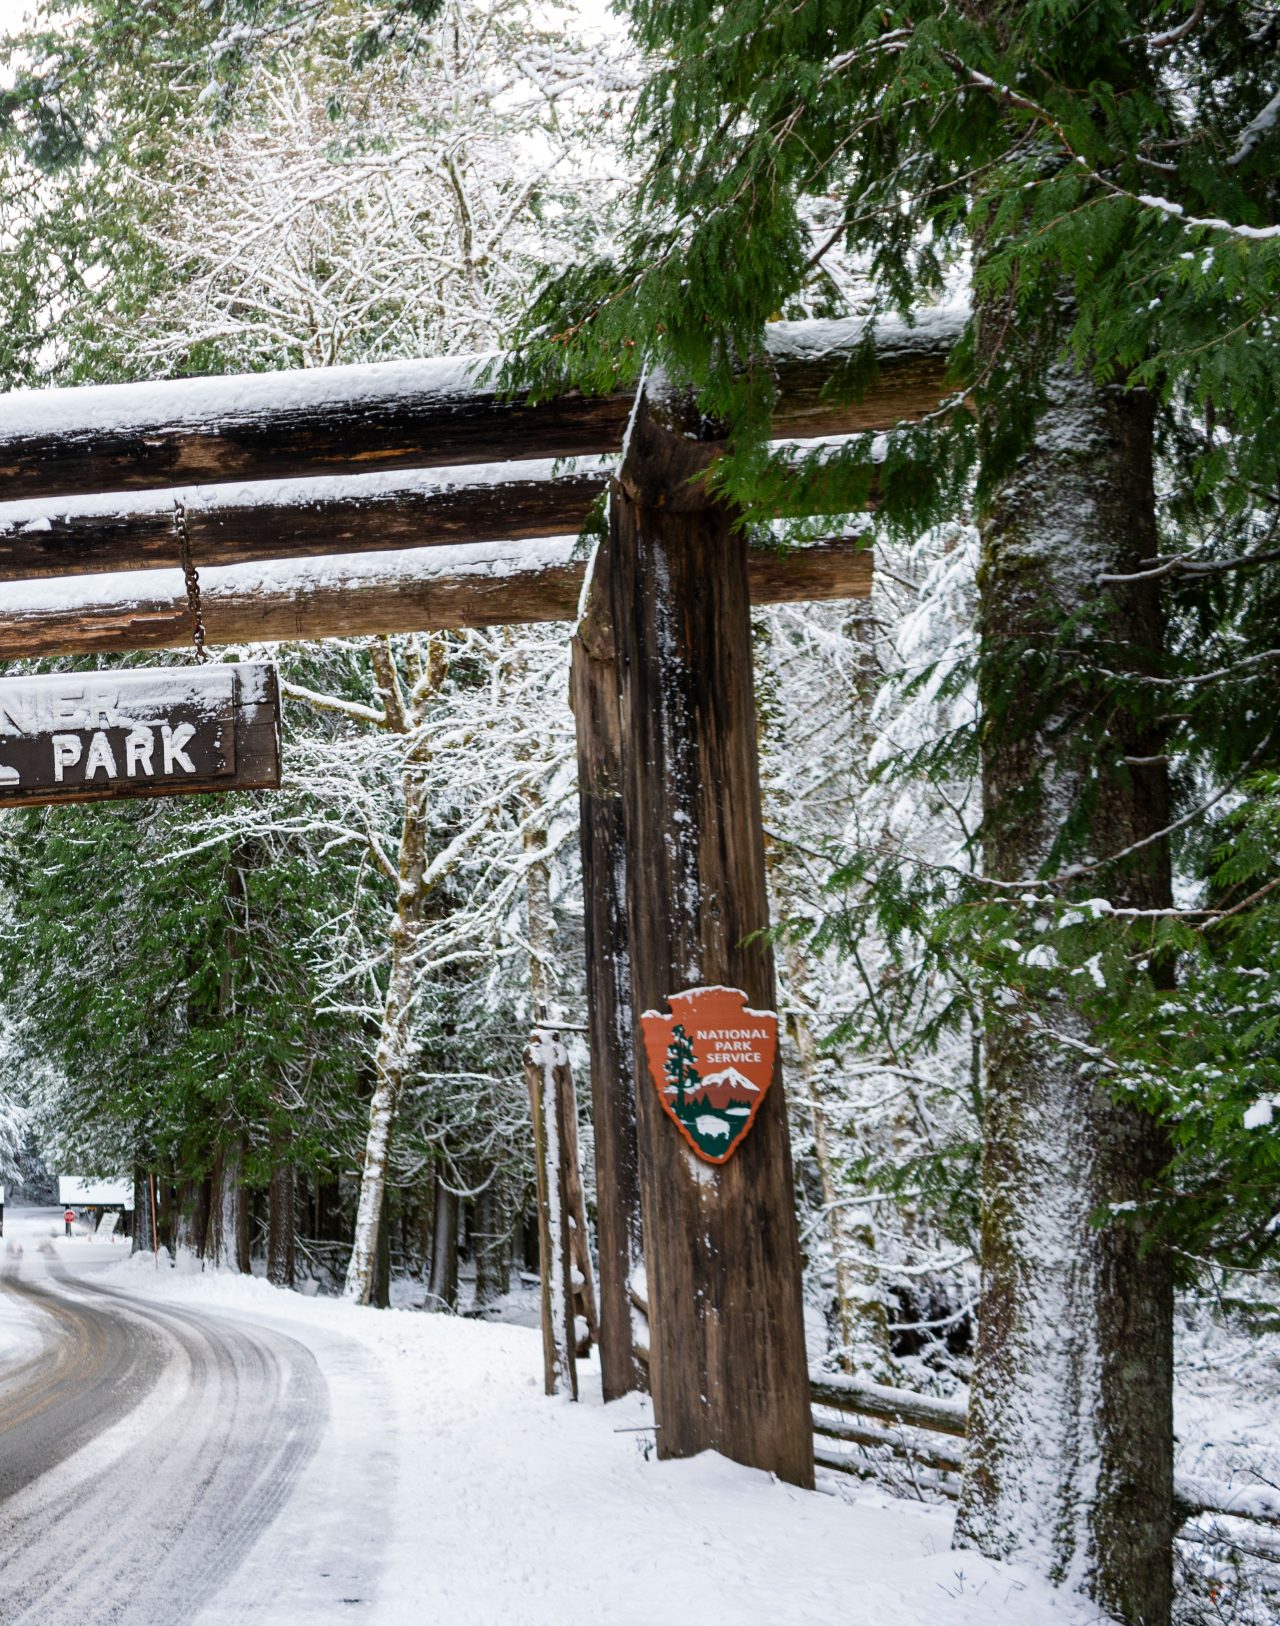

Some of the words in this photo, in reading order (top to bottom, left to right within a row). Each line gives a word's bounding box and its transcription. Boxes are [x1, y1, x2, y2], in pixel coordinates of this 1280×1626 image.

[51, 723, 197, 783] PARK
[697, 1029, 769, 1040] NATIONAL
[716, 1041, 752, 1051] PARK
[706, 1053, 761, 1063] SERVICE
